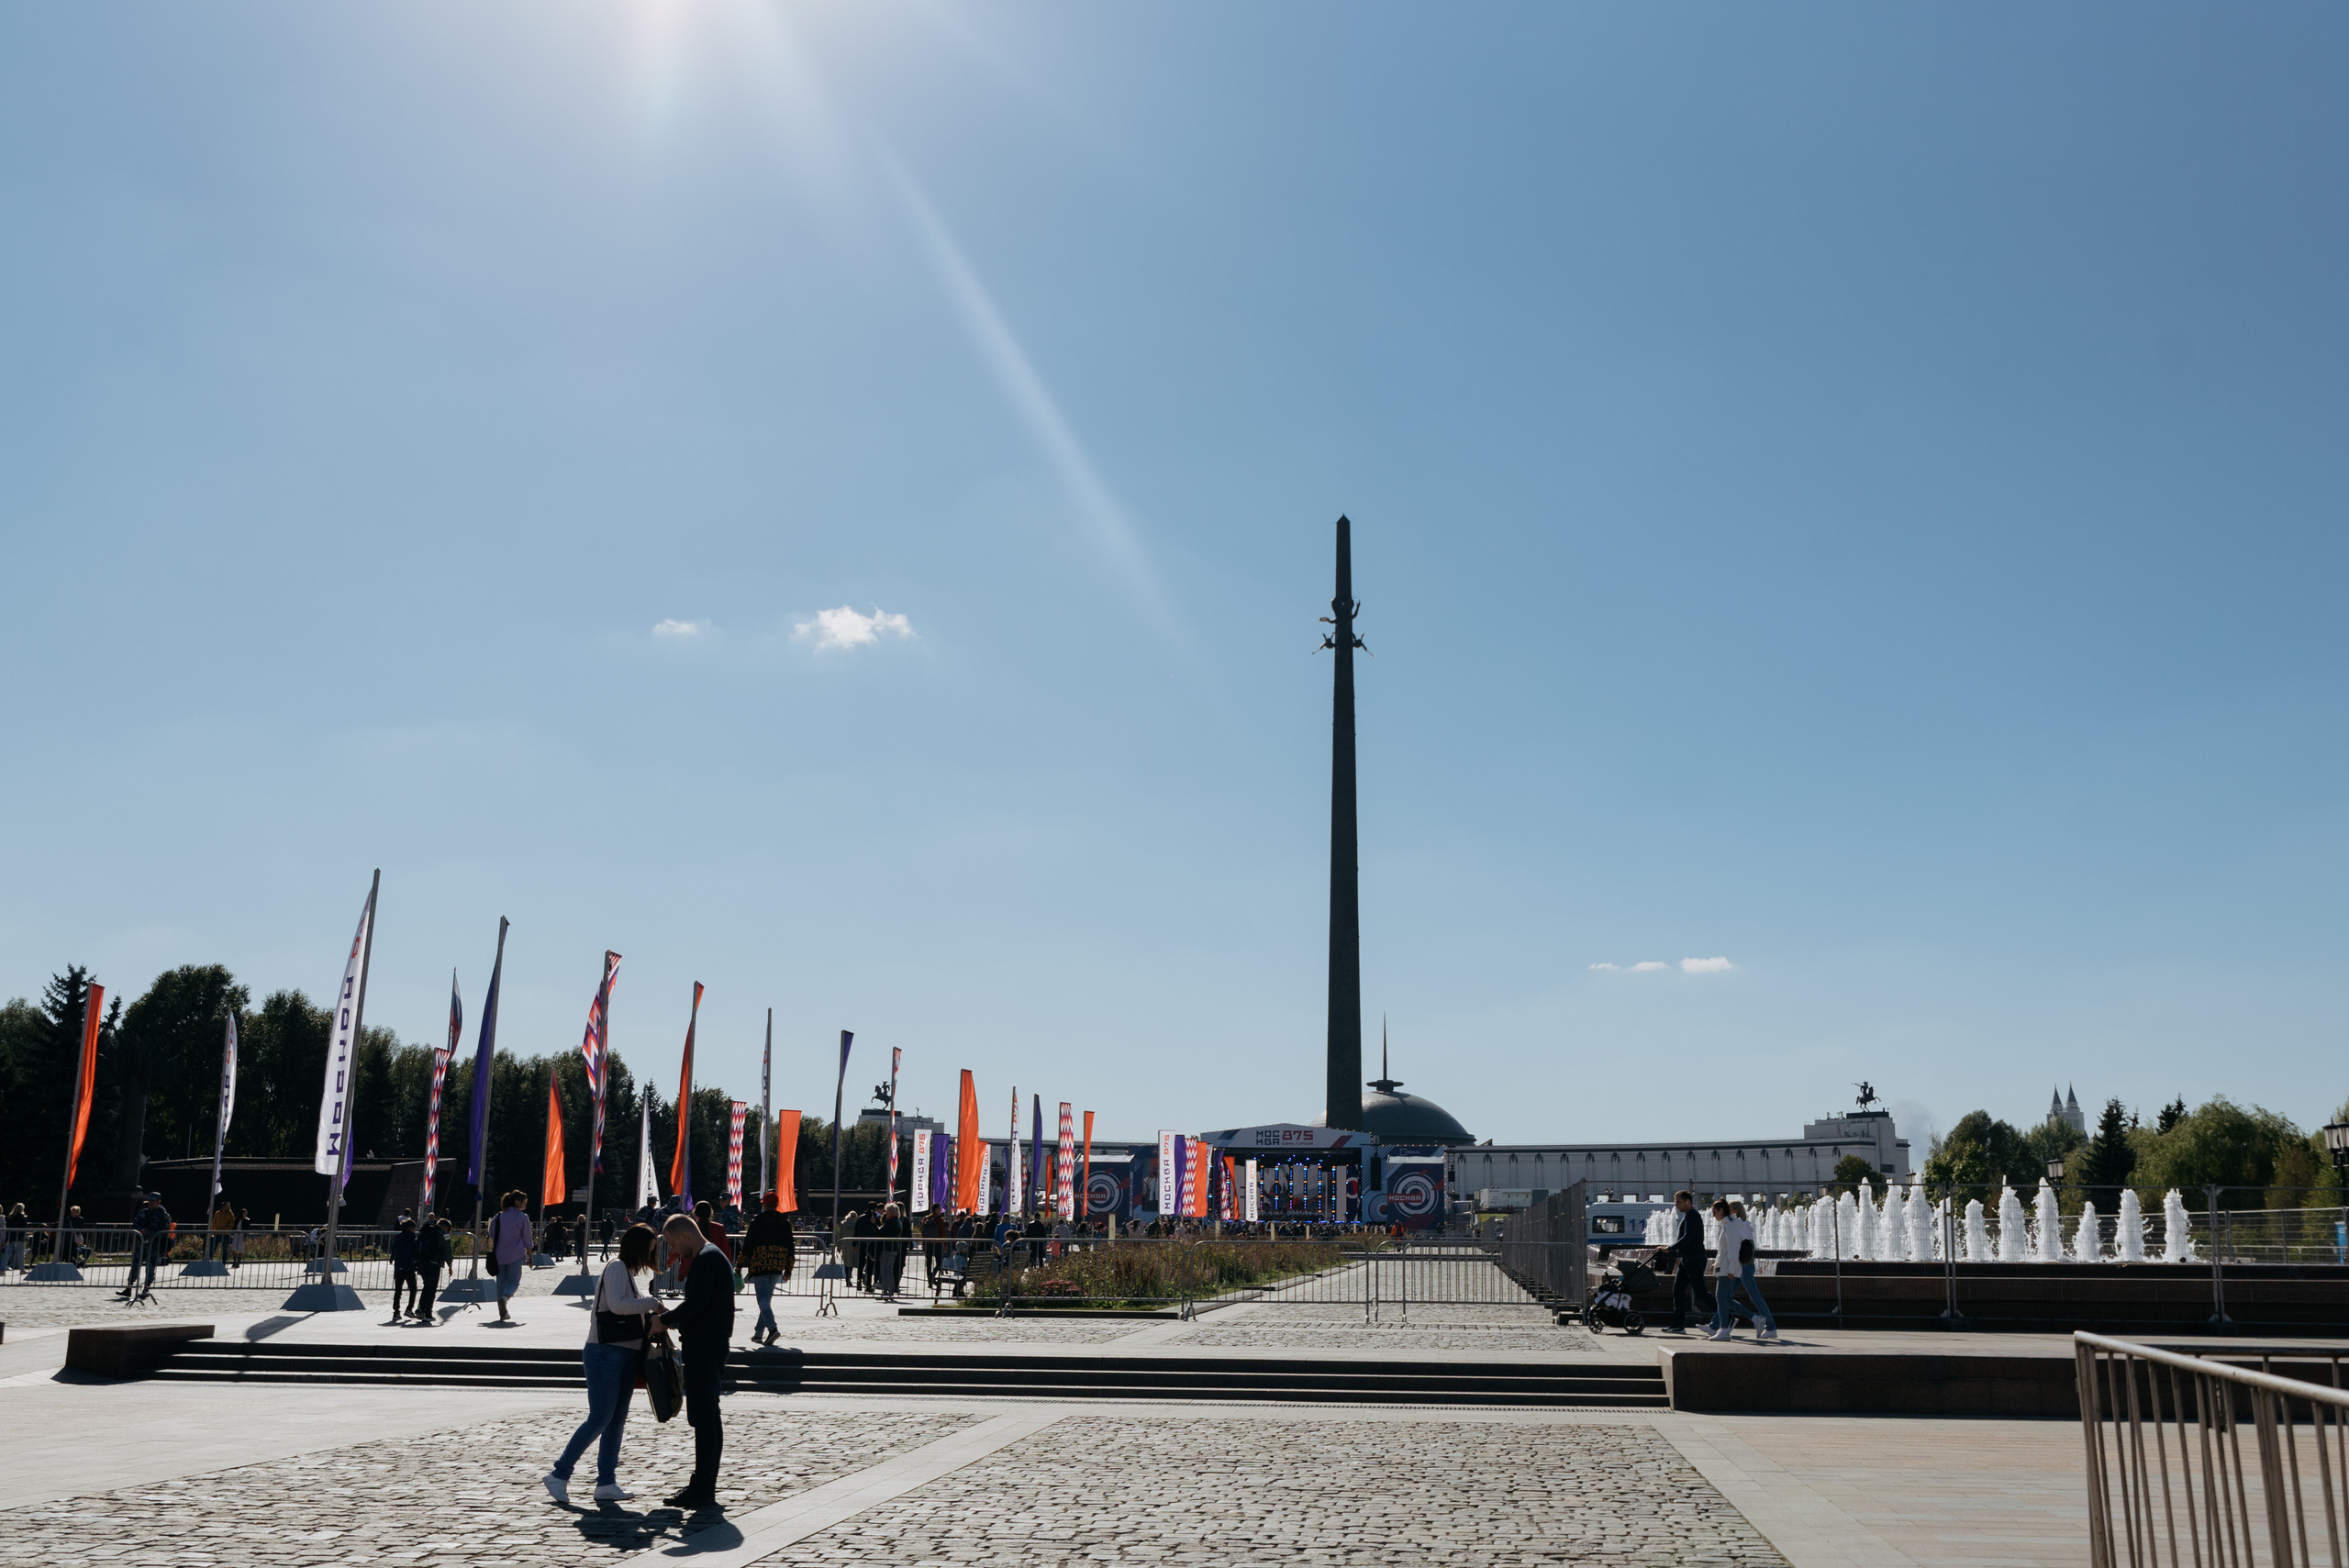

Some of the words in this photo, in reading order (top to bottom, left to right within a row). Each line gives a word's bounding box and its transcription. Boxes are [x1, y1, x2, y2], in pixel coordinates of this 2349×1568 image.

[1255, 1129, 1280, 1138] МОС
[1282, 1129, 1314, 1140] 875
[1255, 1138, 1280, 1146] КВА
